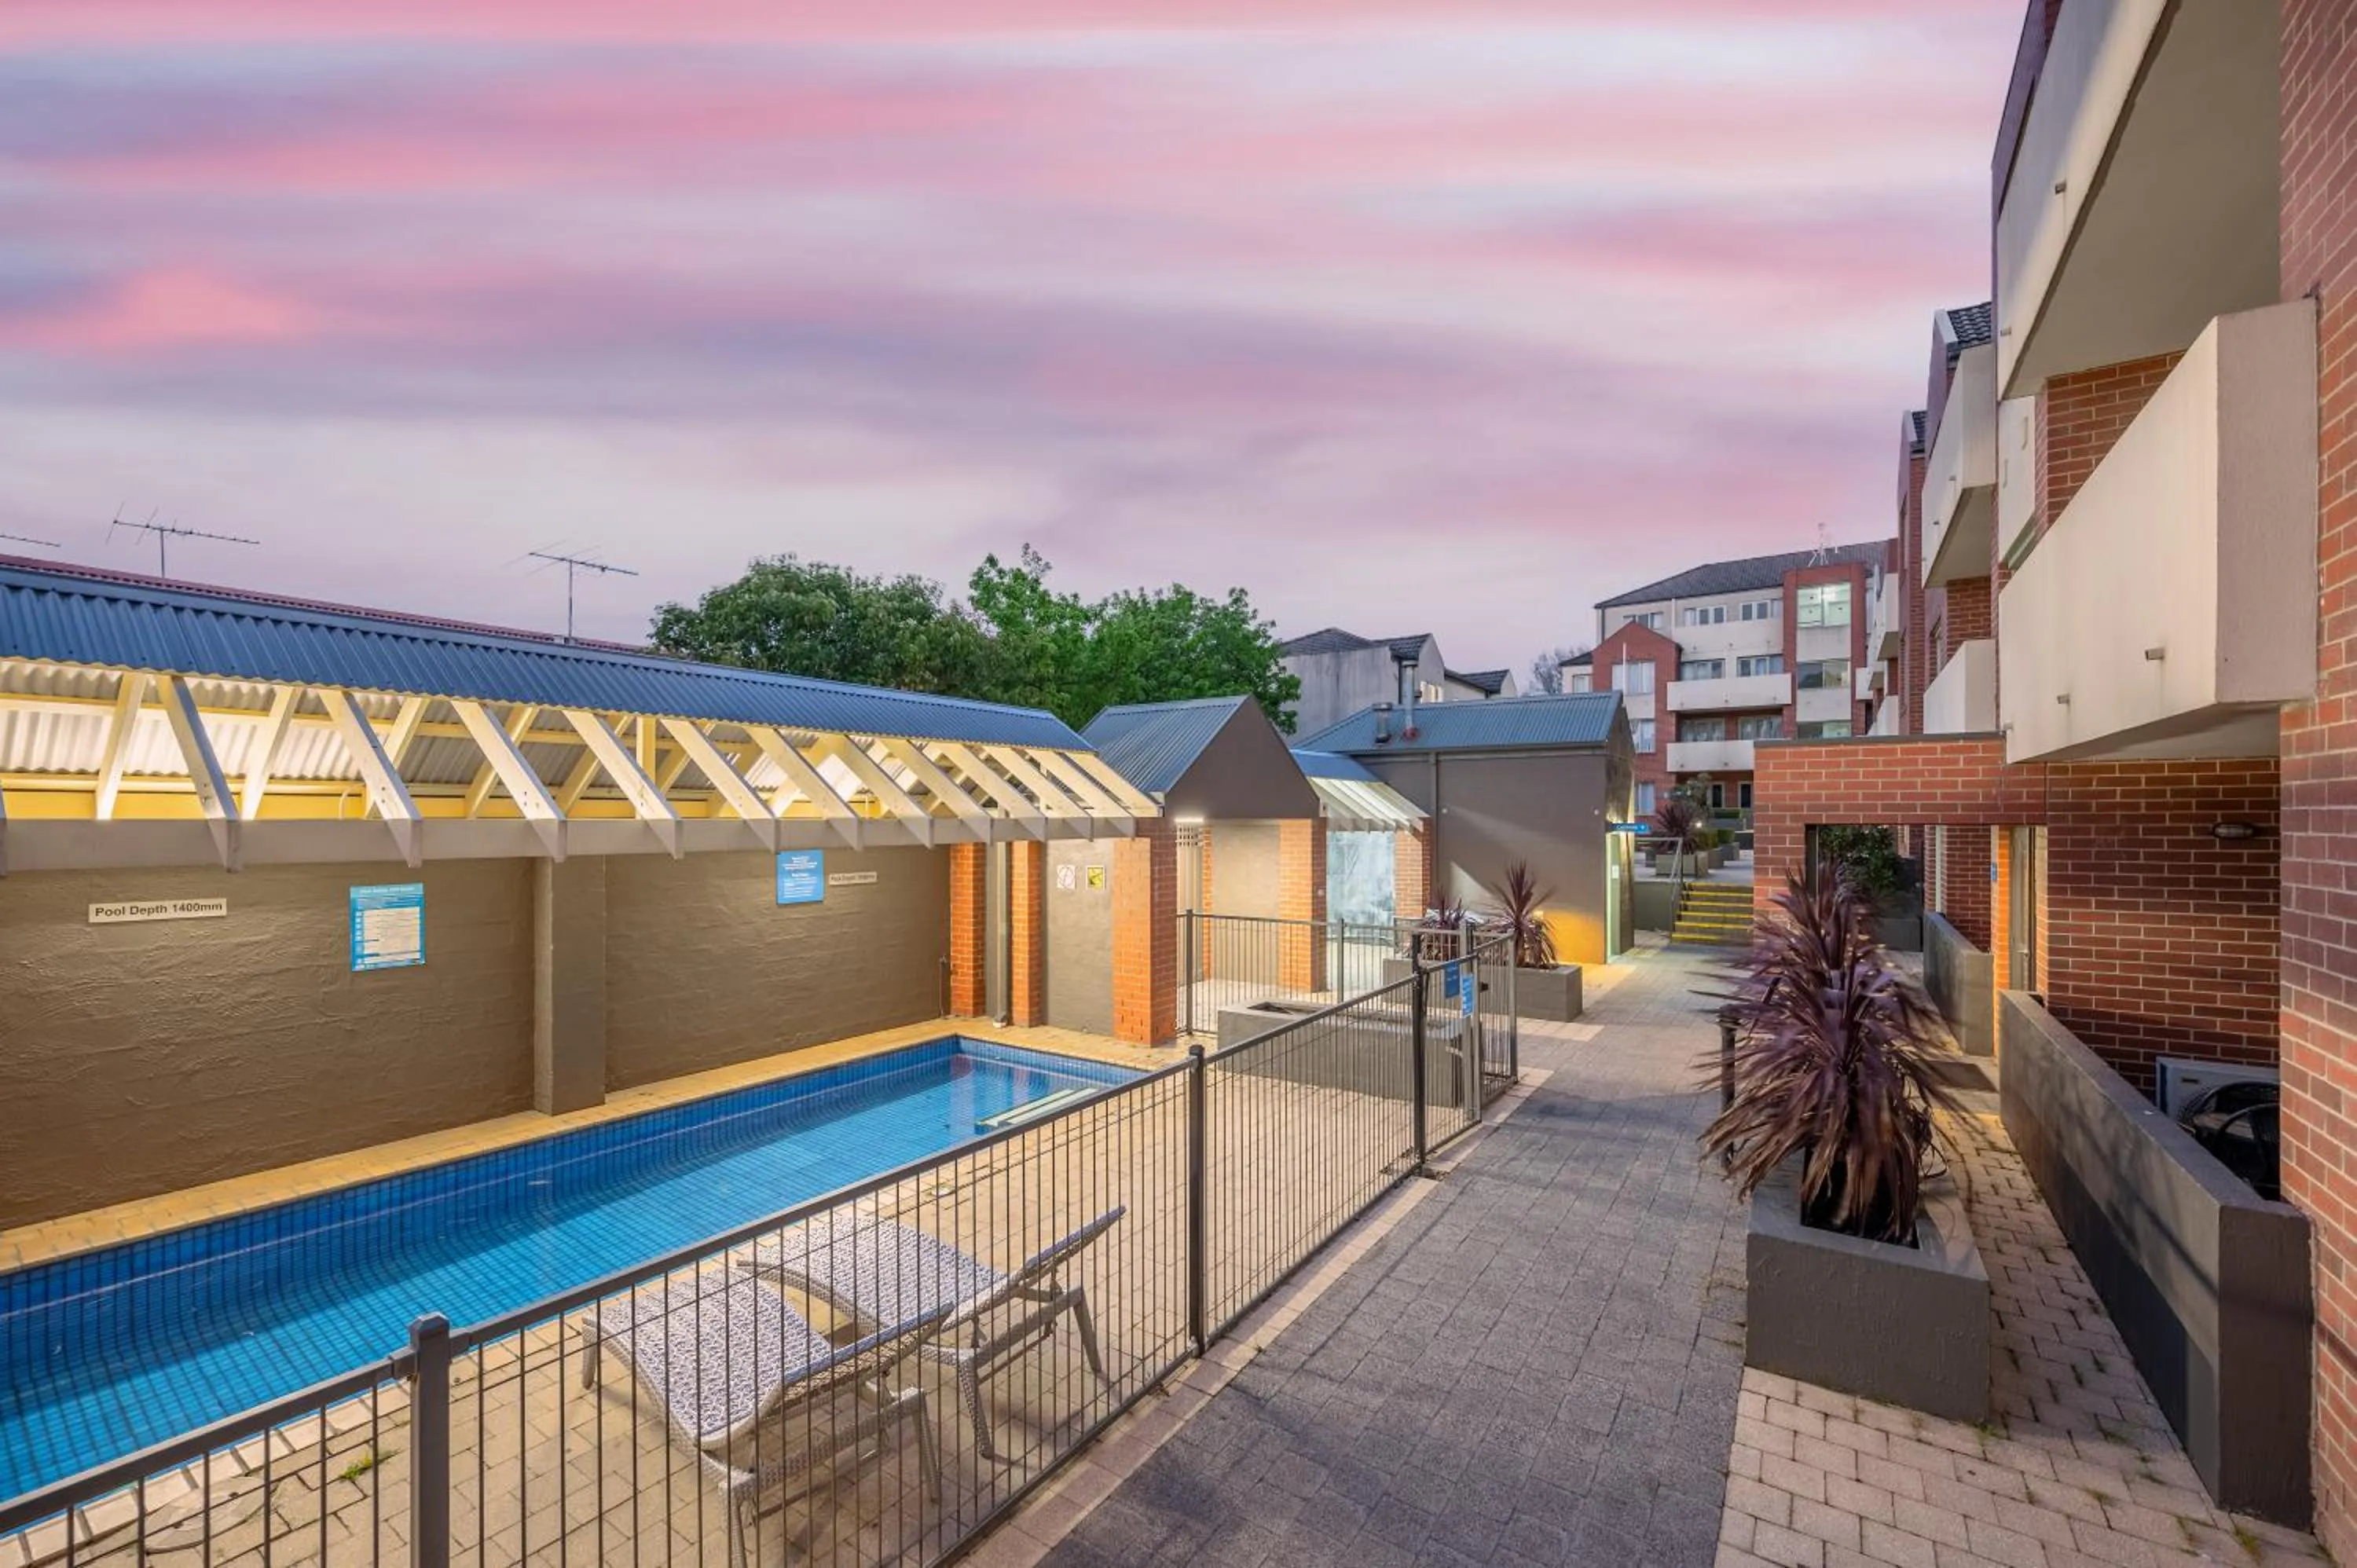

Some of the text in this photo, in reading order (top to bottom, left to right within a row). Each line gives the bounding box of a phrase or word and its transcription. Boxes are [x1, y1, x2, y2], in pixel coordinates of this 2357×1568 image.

[95, 903, 222, 917] Pool Depth 1400mm
